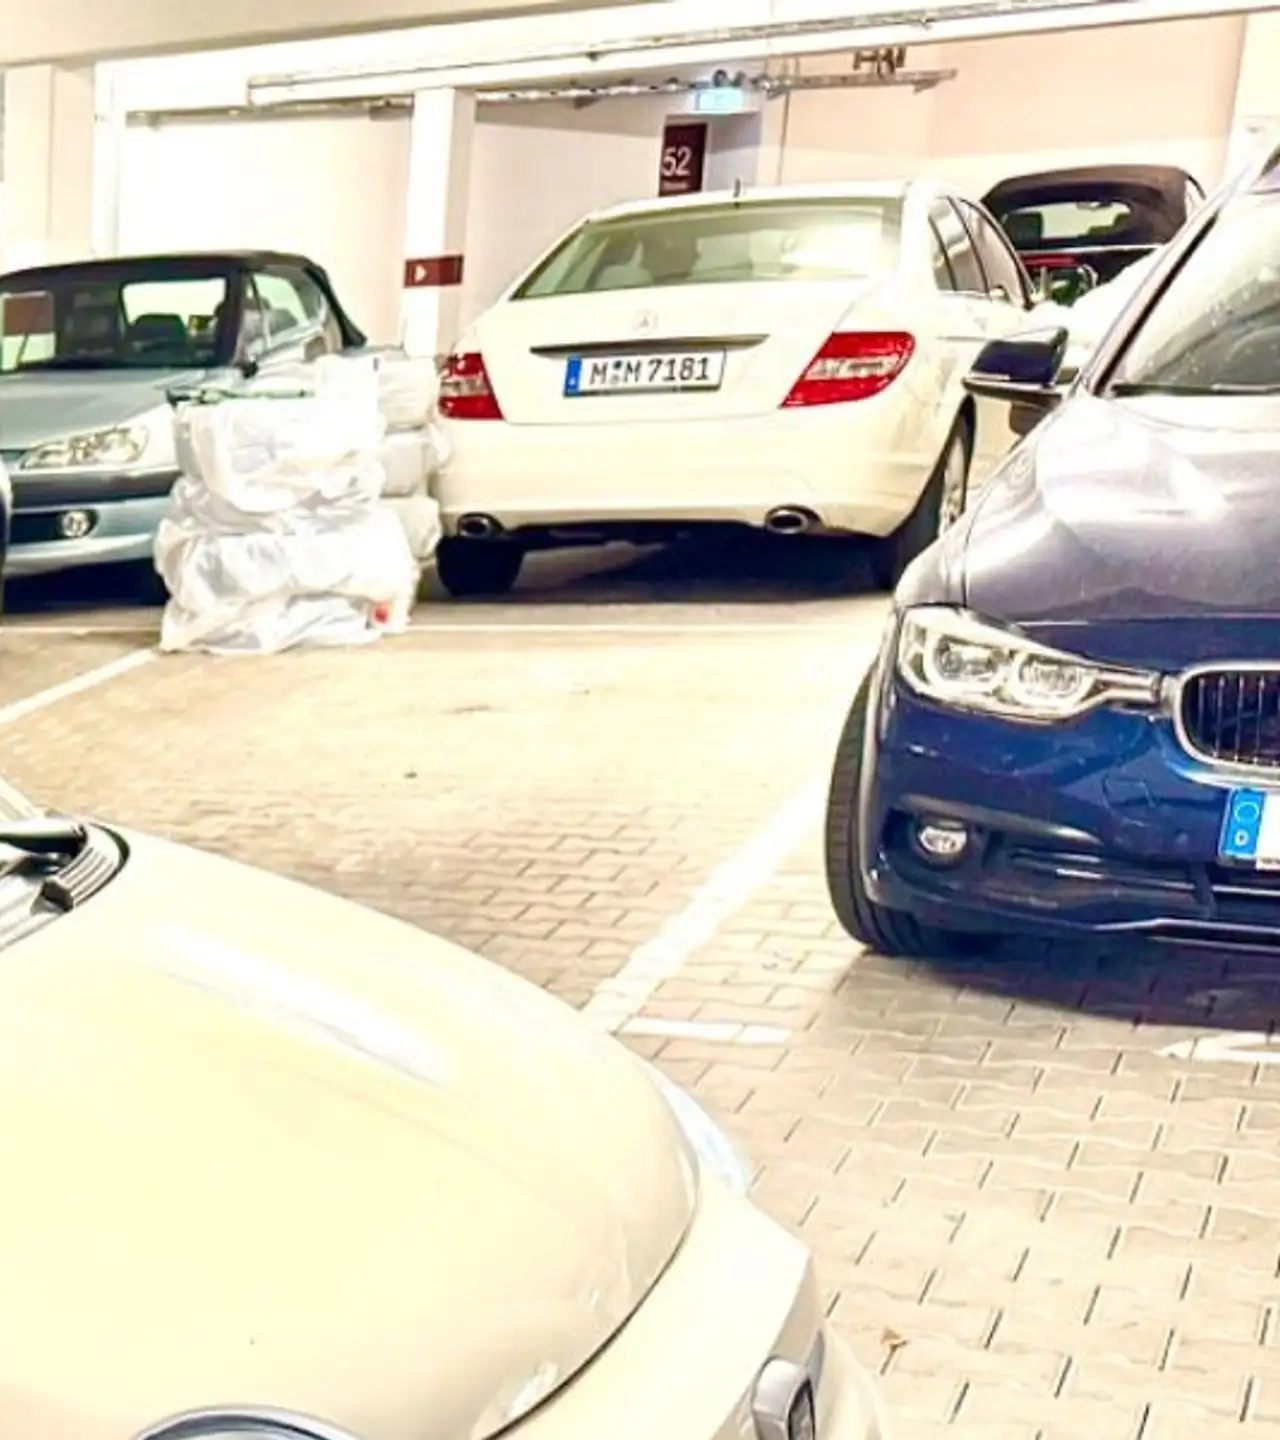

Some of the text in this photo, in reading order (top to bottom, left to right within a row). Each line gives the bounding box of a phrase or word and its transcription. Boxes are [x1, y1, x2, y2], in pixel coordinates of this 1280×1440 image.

[661, 145, 693, 177] 52
[590, 360, 609, 385] M
[647, 355, 711, 383] 7181
